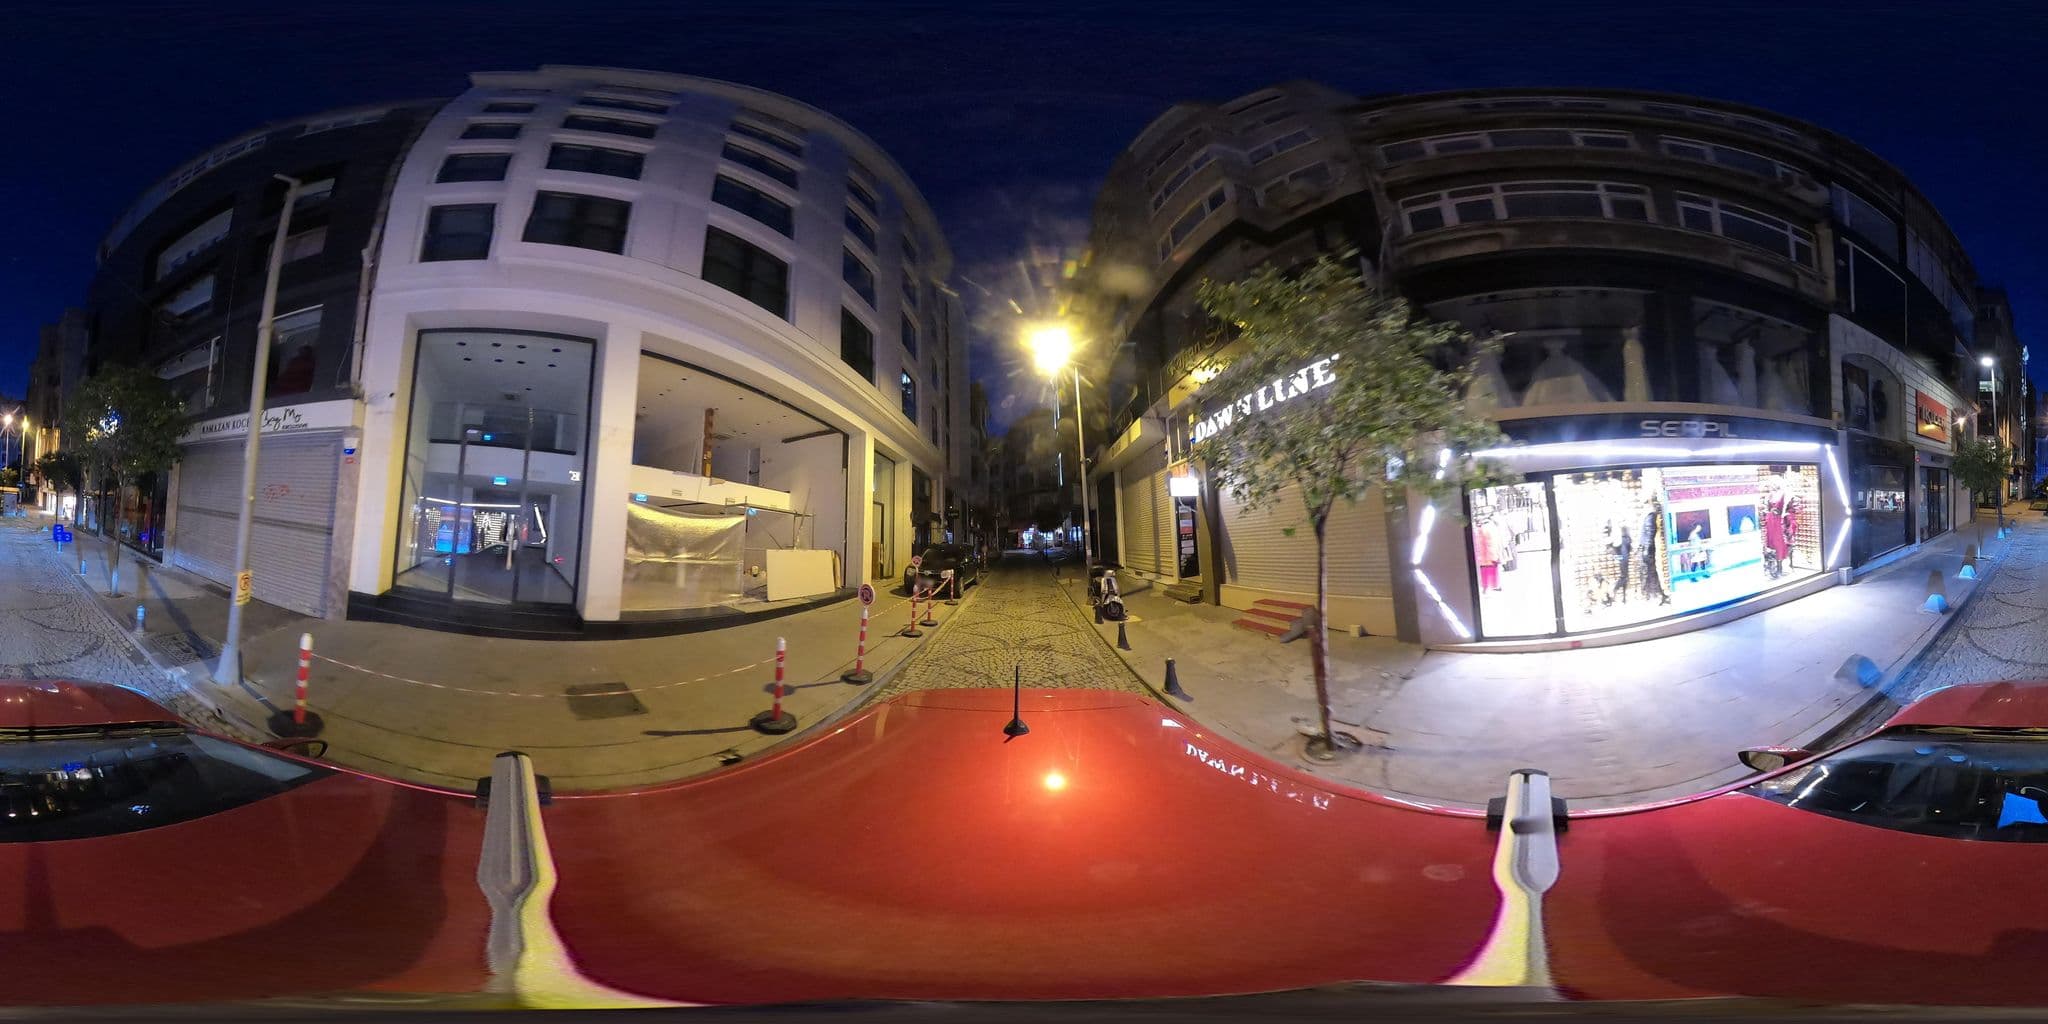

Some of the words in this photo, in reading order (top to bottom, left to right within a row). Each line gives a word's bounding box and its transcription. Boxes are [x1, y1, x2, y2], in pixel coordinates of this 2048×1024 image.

[1195, 394, 1252, 443] DAWN
[1257, 358, 1335, 411] LINE
[1640, 420, 1737, 438] SERPIL
